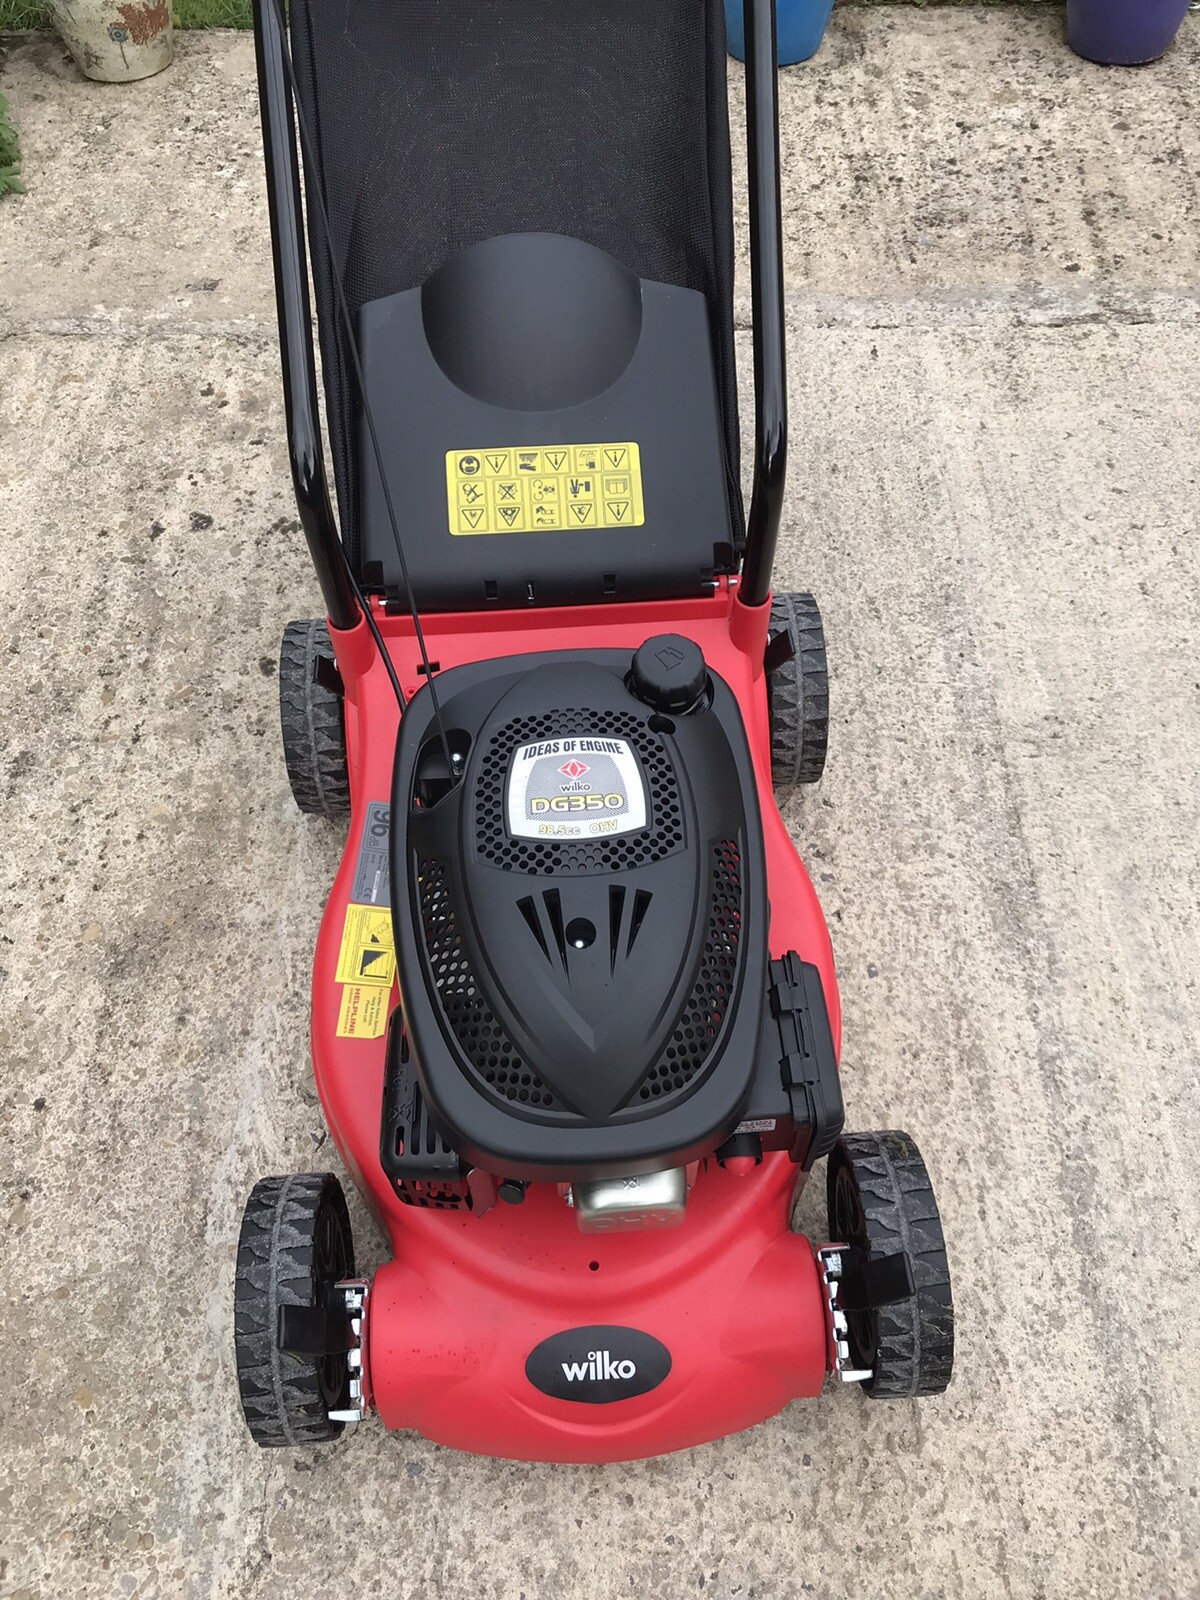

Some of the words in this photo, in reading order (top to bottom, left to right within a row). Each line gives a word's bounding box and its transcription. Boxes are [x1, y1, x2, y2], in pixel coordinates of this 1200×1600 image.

[523, 742, 560, 760] IDEAS
[563, 740, 577, 752] OF
[580, 740, 624, 754] ENGINE
[560, 782, 591, 792] wilko
[530, 793, 624, 814] DG350
[371, 810, 390, 837] 96
[539, 824, 581, 836] 98.5cc
[589, 820, 618, 833] OHV
[348, 988, 361, 1034] HELPLINE
[561, 1350, 636, 1381] wilko
